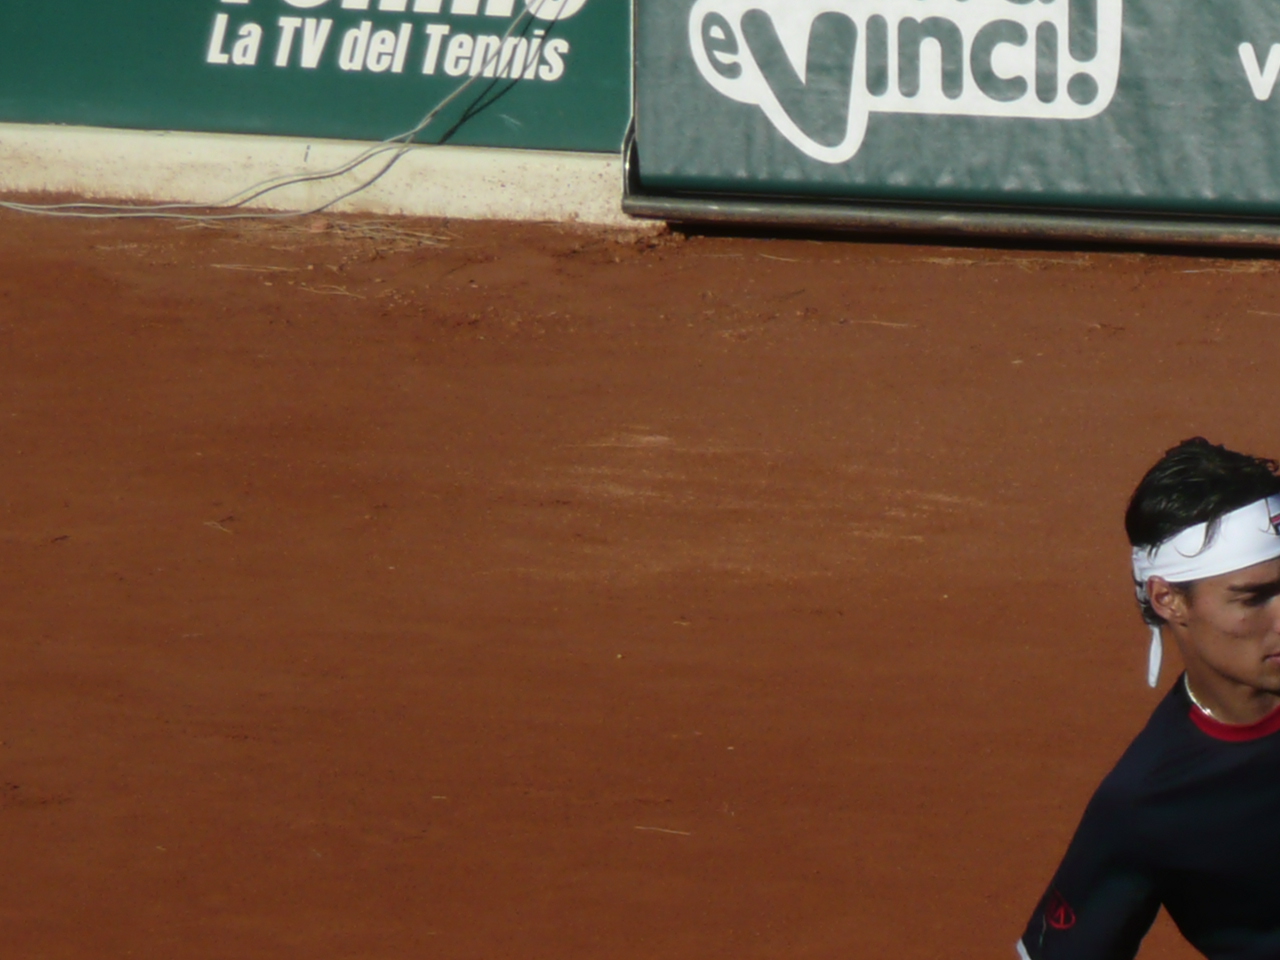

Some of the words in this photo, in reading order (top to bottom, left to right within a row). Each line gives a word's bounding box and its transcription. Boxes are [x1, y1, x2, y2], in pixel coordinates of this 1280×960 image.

[206, 13, 263, 66] La
[275, 16, 333, 69] TV
[338, 20, 413, 74] del
[422, 23, 570, 81] Tennis
